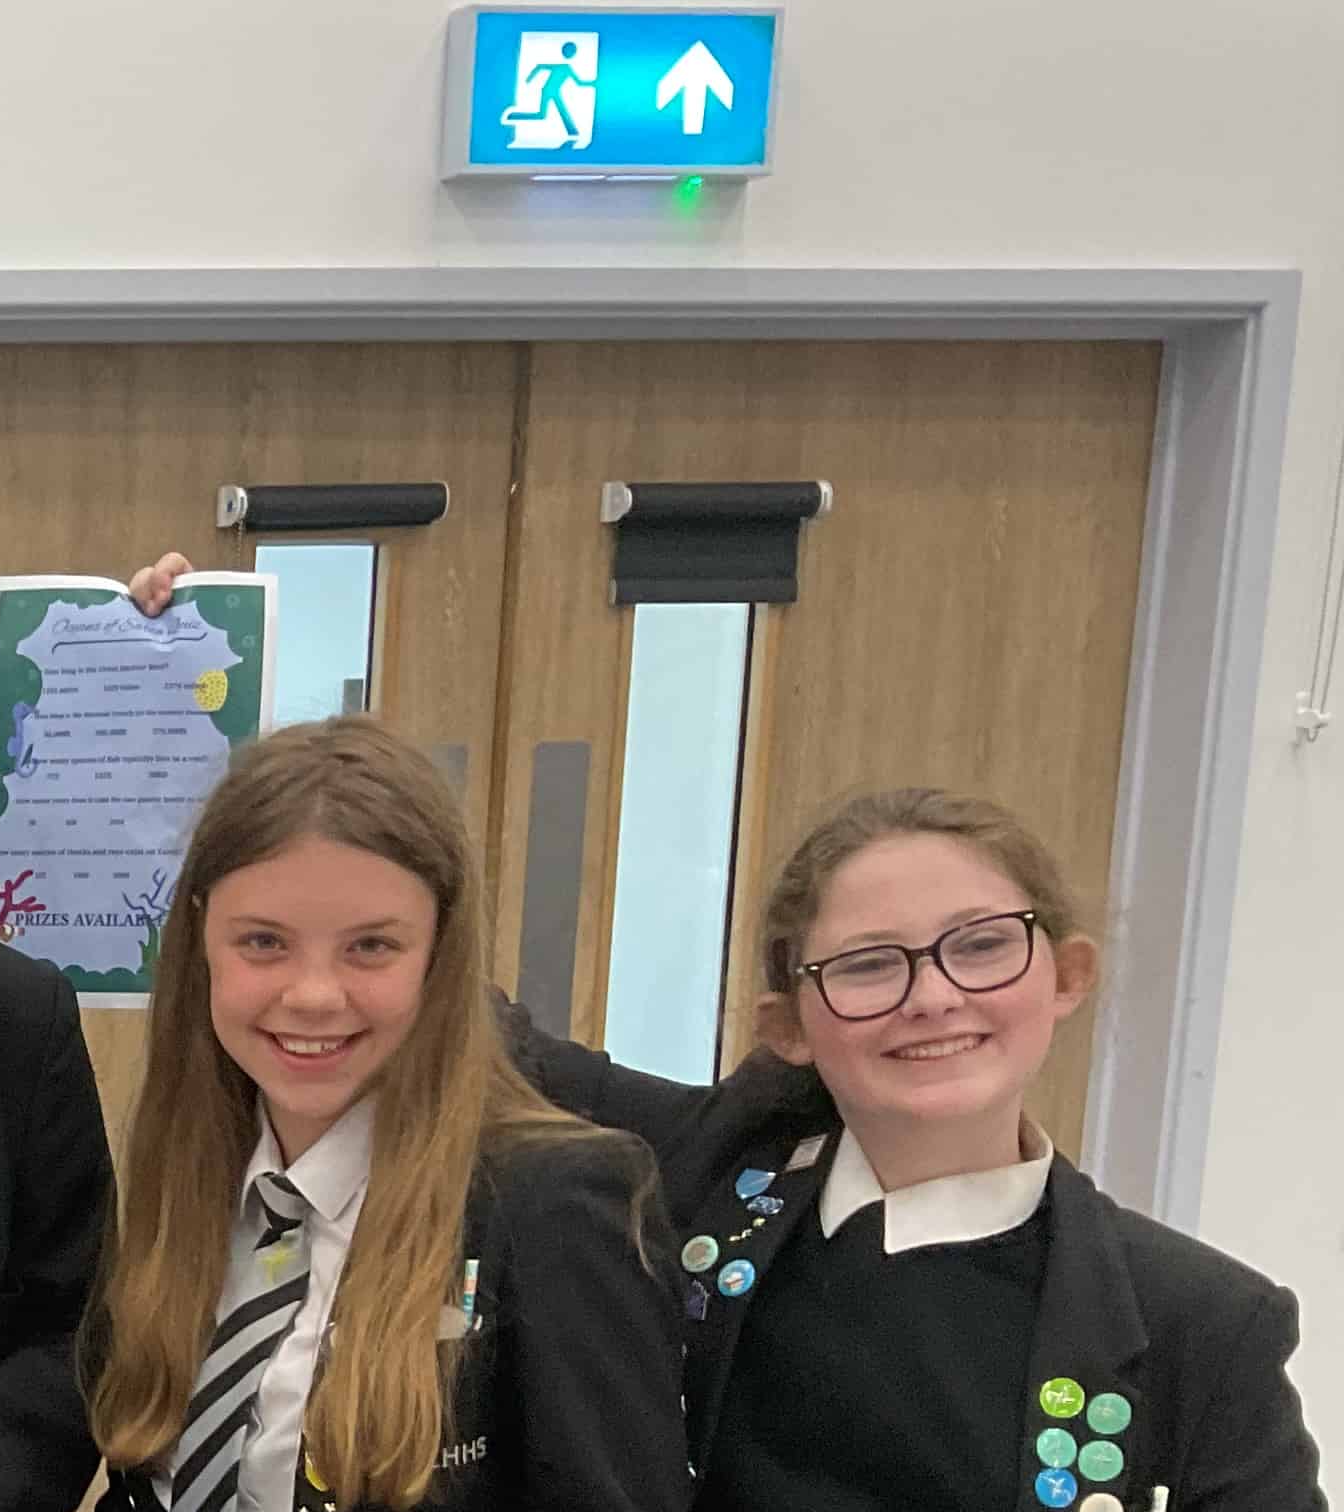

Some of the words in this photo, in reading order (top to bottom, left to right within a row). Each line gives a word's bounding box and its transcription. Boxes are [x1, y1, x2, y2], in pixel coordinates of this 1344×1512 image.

[15, 913, 69, 927] PRIZES
[73, 912, 166, 928] AVAILAB
[432, 1436, 489, 1468] HHS
